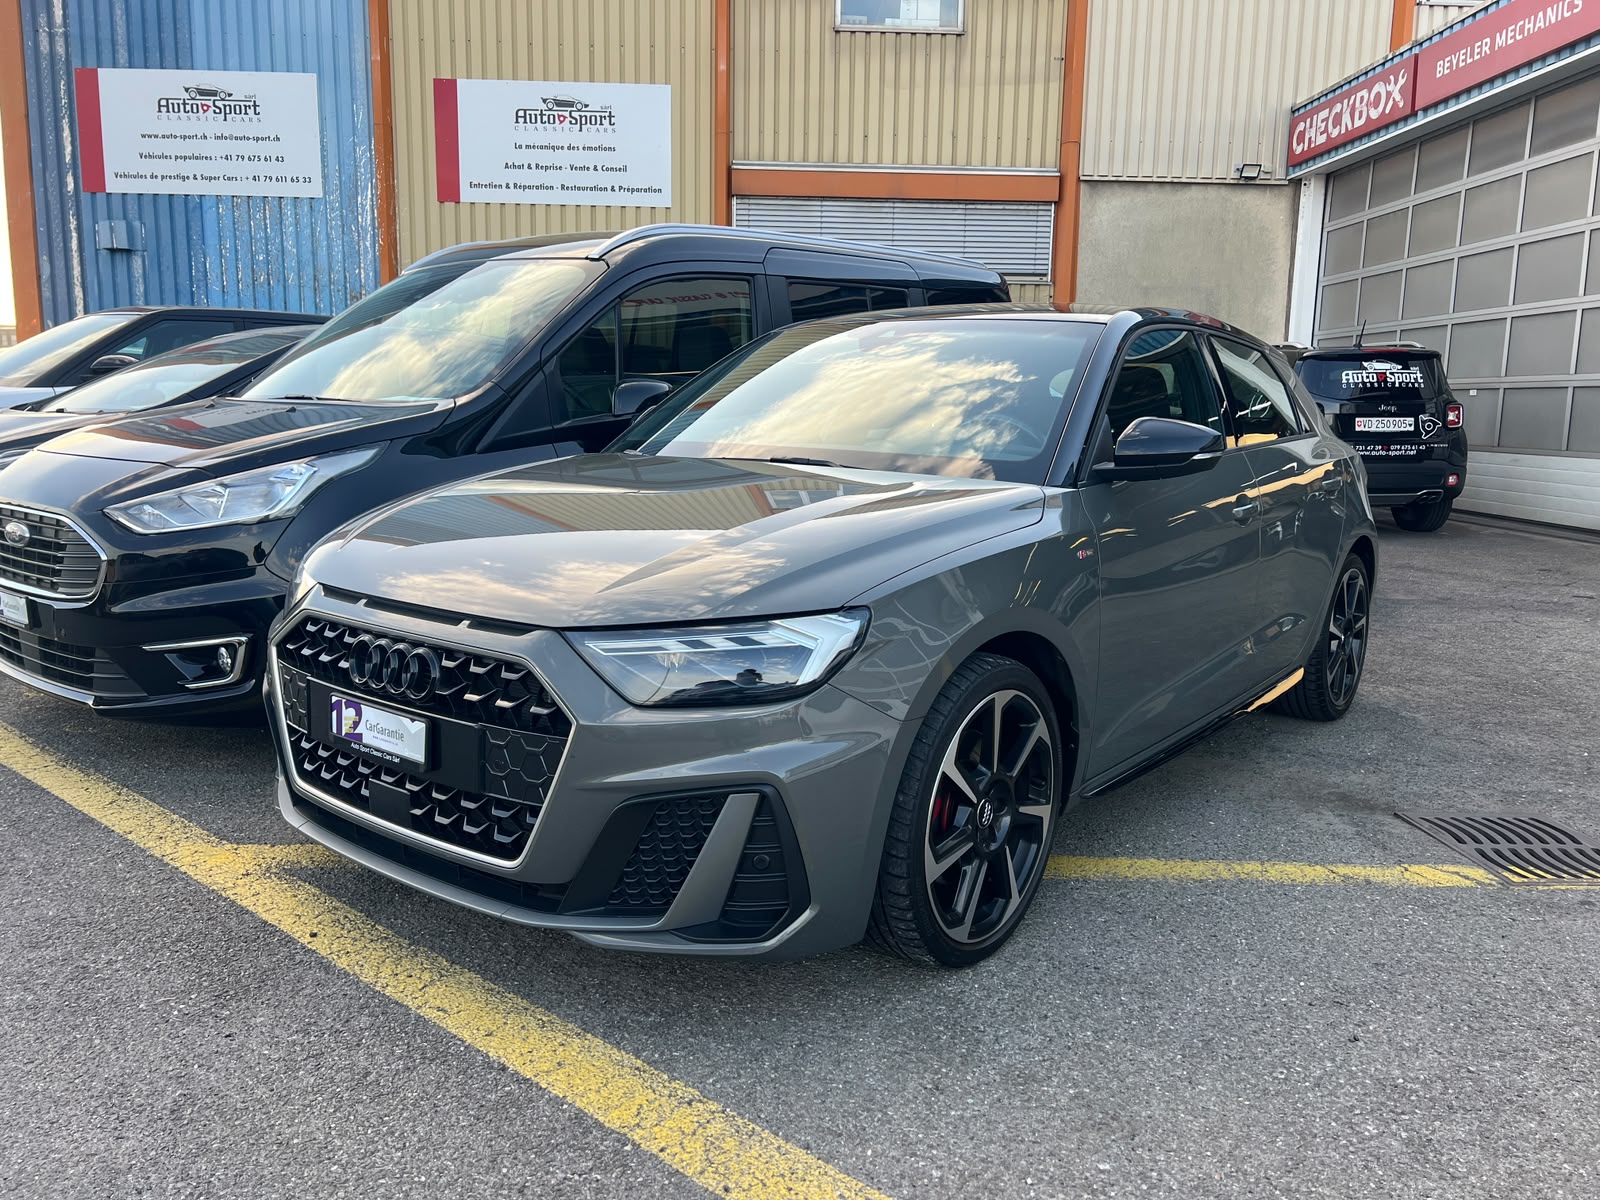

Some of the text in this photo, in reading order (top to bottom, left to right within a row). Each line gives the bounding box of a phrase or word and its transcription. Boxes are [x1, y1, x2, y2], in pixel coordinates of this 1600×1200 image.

[1436, 0, 1582, 78] BEYELER MECHANICS
[157, 98, 260, 121] Auto Sport
[1292, 69, 1407, 154] CHECKBOX
[515, 109, 615, 132] Auto Sport
[140, 132, 208, 141] www.auto-sport.ch
[214, 134, 280, 143] info@auto-sport.ch
[525, 142, 564, 152] mécanique
[567, 143, 580, 151] des
[583, 144, 616, 152] émotions
[139, 152, 172, 160] Véhicules
[175, 153, 212, 163] populaires
[535, 164, 562, 172] Reprise
[570, 164, 590, 172] Vente
[114, 172, 147, 180] Véhicules
[161, 173, 190, 182] prestige
[200, 174, 220, 182] Super
[302, 176, 312, 184] 33
[514, 182, 554, 191] Réparation
[561, 184, 608, 192] Restauration
[619, 185, 662, 194] Préparation
[1342, 370, 1423, 386] Auto Sport
[1378, 404, 1397, 412] Jeep
[1363, 419, 1372, 429] VD
[332, 699, 363, 742] 12
[365, 720, 404, 741] CarGarantie
